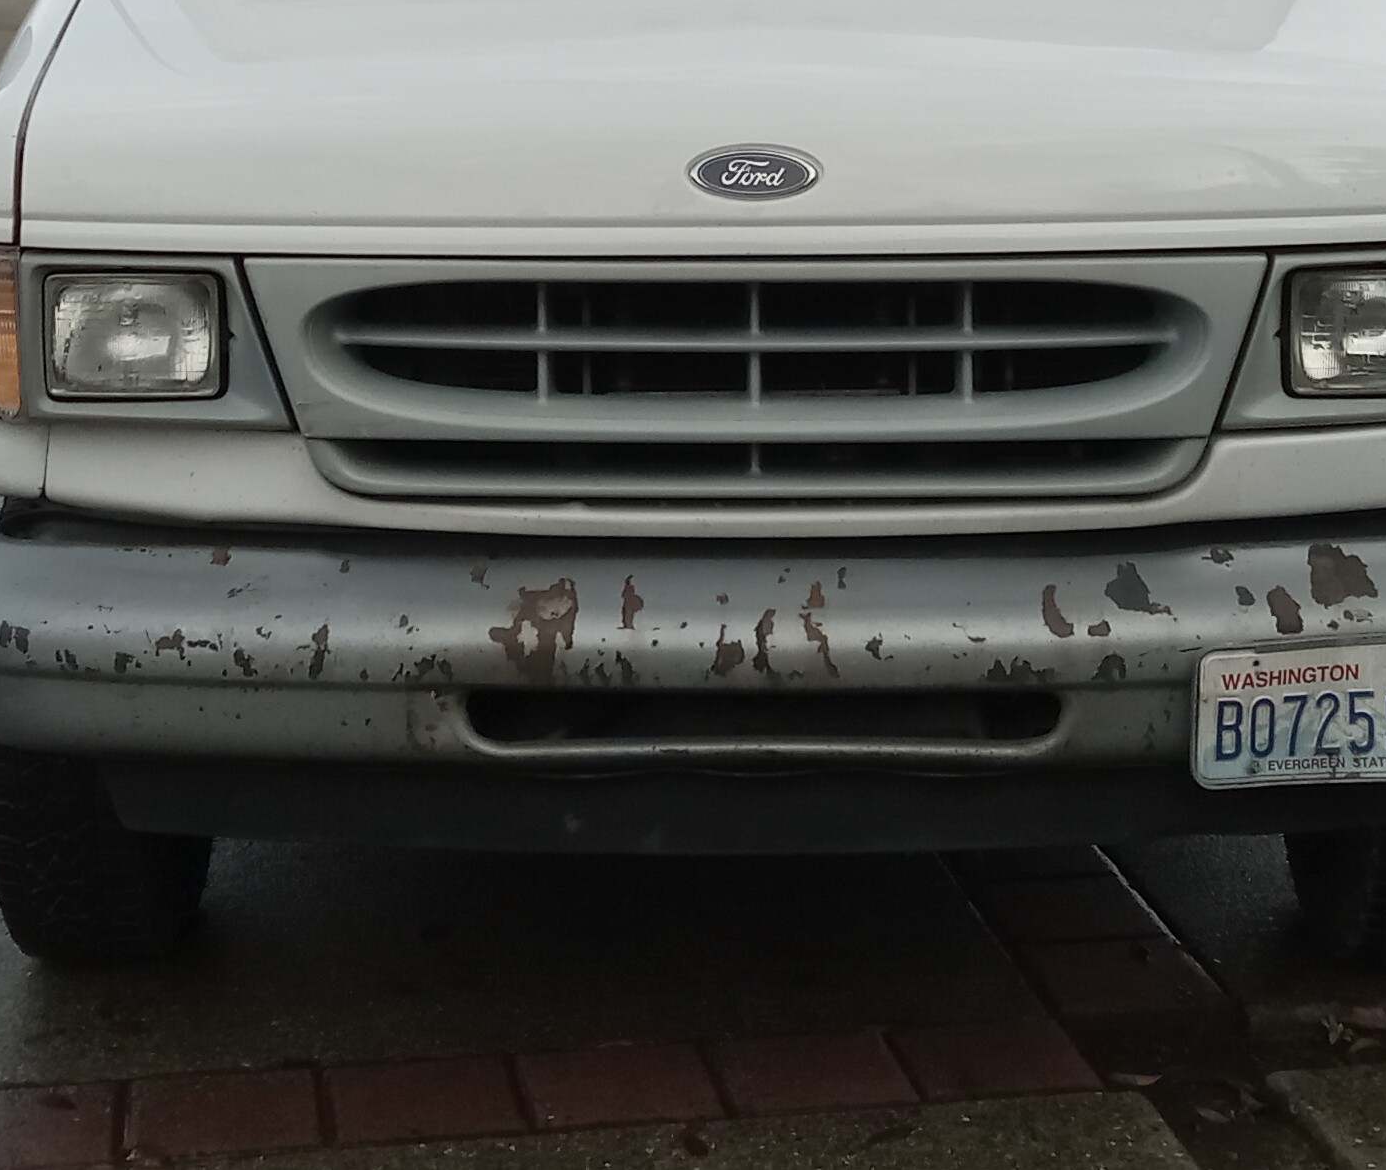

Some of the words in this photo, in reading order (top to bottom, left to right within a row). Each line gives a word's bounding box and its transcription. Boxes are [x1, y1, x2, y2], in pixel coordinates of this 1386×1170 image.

[721, 159, 785, 186] Ford
[1221, 664, 1360, 690] WASHINGTON
[1268, 758, 1346, 771] EVERGREEN
